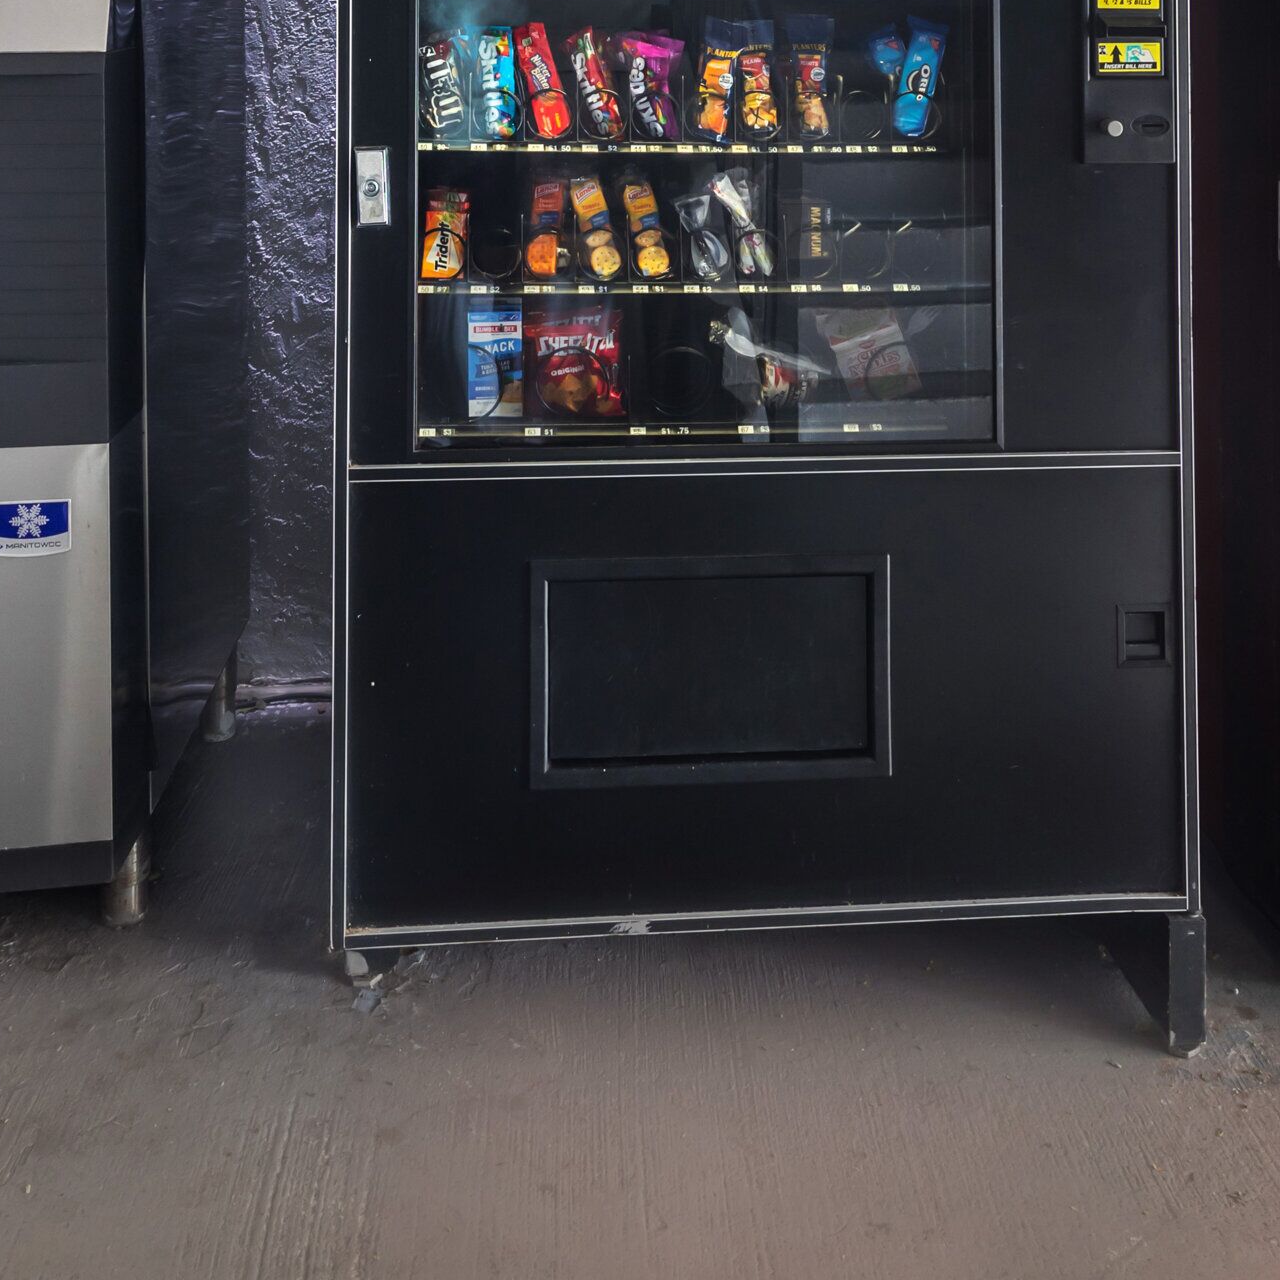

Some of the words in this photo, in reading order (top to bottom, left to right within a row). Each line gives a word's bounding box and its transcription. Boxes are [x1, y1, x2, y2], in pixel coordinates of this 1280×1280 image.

[706, 46, 739, 59] PLANTE
[792, 43, 827, 52] PLANTERS
[530, 53, 552, 79] Nutter
[530, 67, 551, 90] Butter
[916, 64, 931, 101] OREO
[479, 39, 503, 135] Skittles
[607, 144, 618, 152] $2
[575, 182, 598, 201] Lance
[627, 186, 650, 201] Lance
[434, 221, 450, 271] Trident
[701, 286, 713, 294] $2
[504, 325, 516, 333] BEE
[477, 340, 516, 357] SNACK
[676, 427, 690, 435] .75
[5, 541, 62, 550] MANITOWOC
